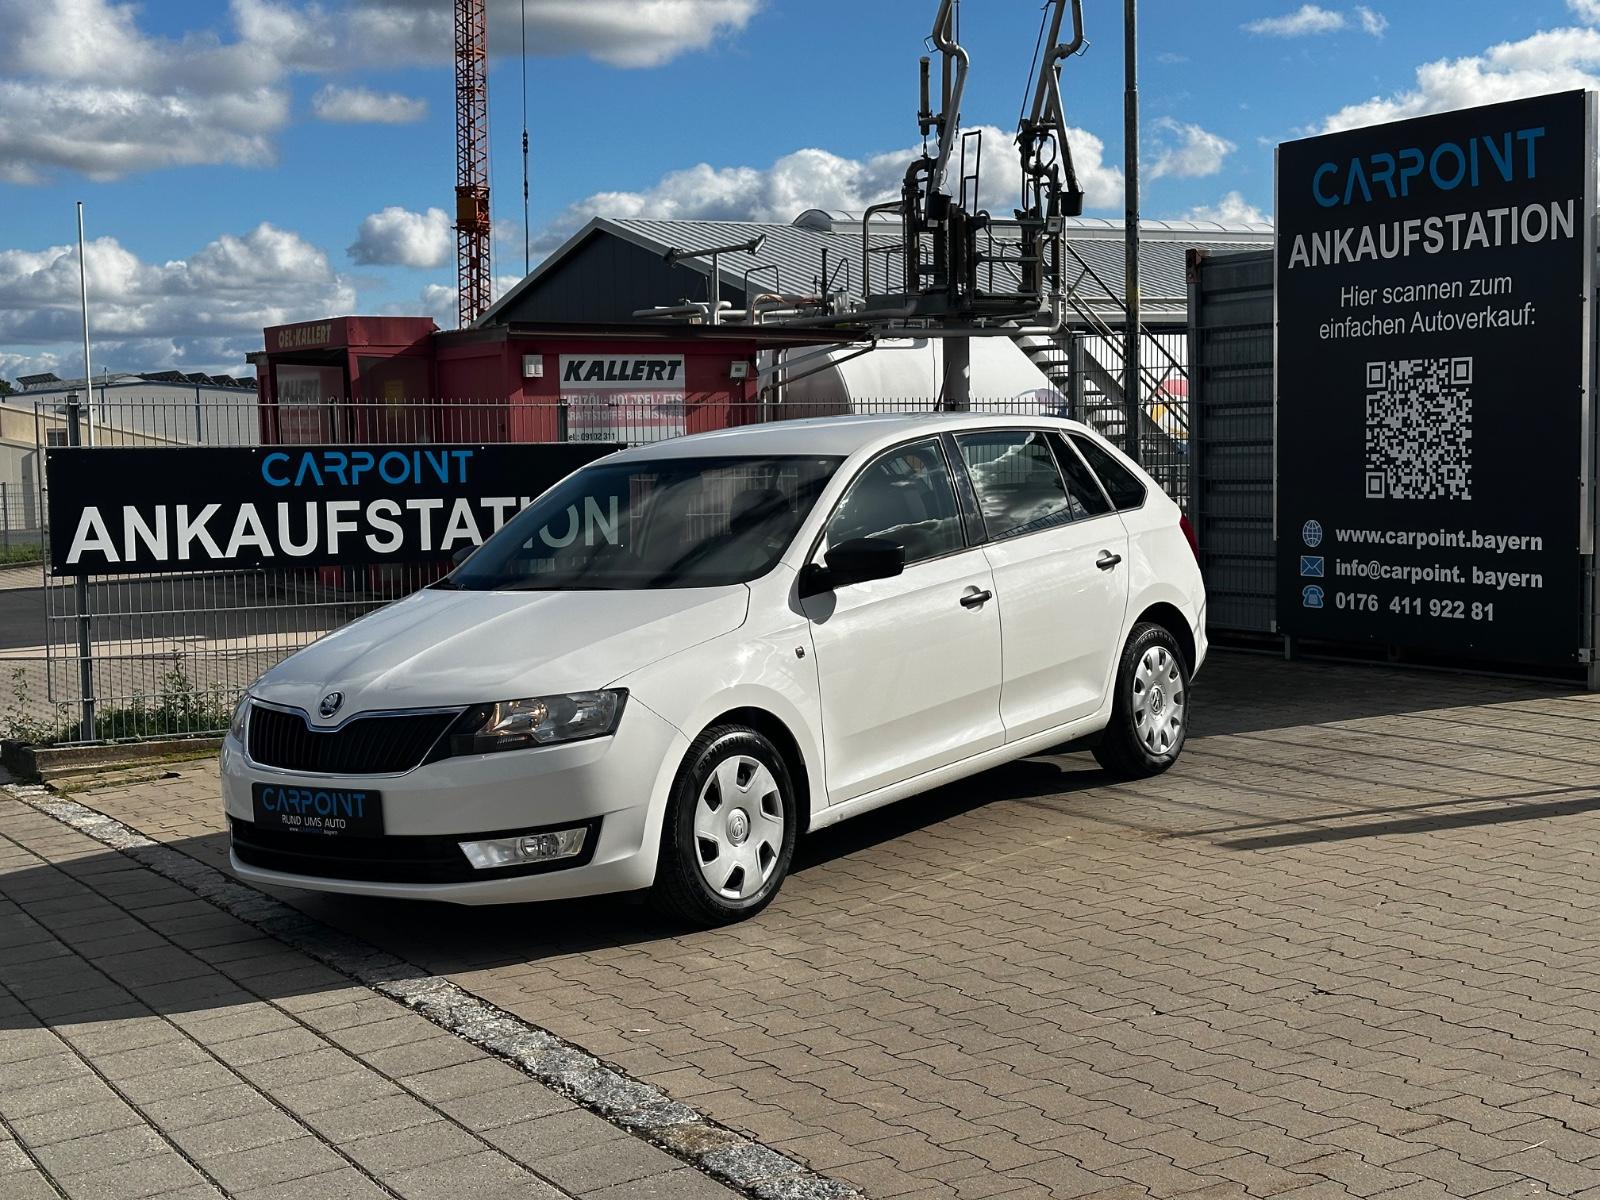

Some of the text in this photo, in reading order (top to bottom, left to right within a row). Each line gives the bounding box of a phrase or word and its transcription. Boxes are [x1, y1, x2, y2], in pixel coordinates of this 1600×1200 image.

[1312, 127, 1545, 207] CARPOINT
[1288, 200, 1574, 269] ANKAUFSTATION
[1340, 276, 1512, 308] Hier scannen zum
[1319, 302, 1536, 339] einfachen Autoverkauf:
[563, 360, 682, 381] KALLERT
[261, 450, 474, 487] CARPOINT
[1335, 528, 1543, 553] www.carpoint.bayern
[1472, 566, 1543, 590] bayern
[1335, 592, 1494, 621] 0176 411 922 81
[262, 788, 366, 817] CARPOINT
[281, 814, 346, 829] RUND UMS AUTO
